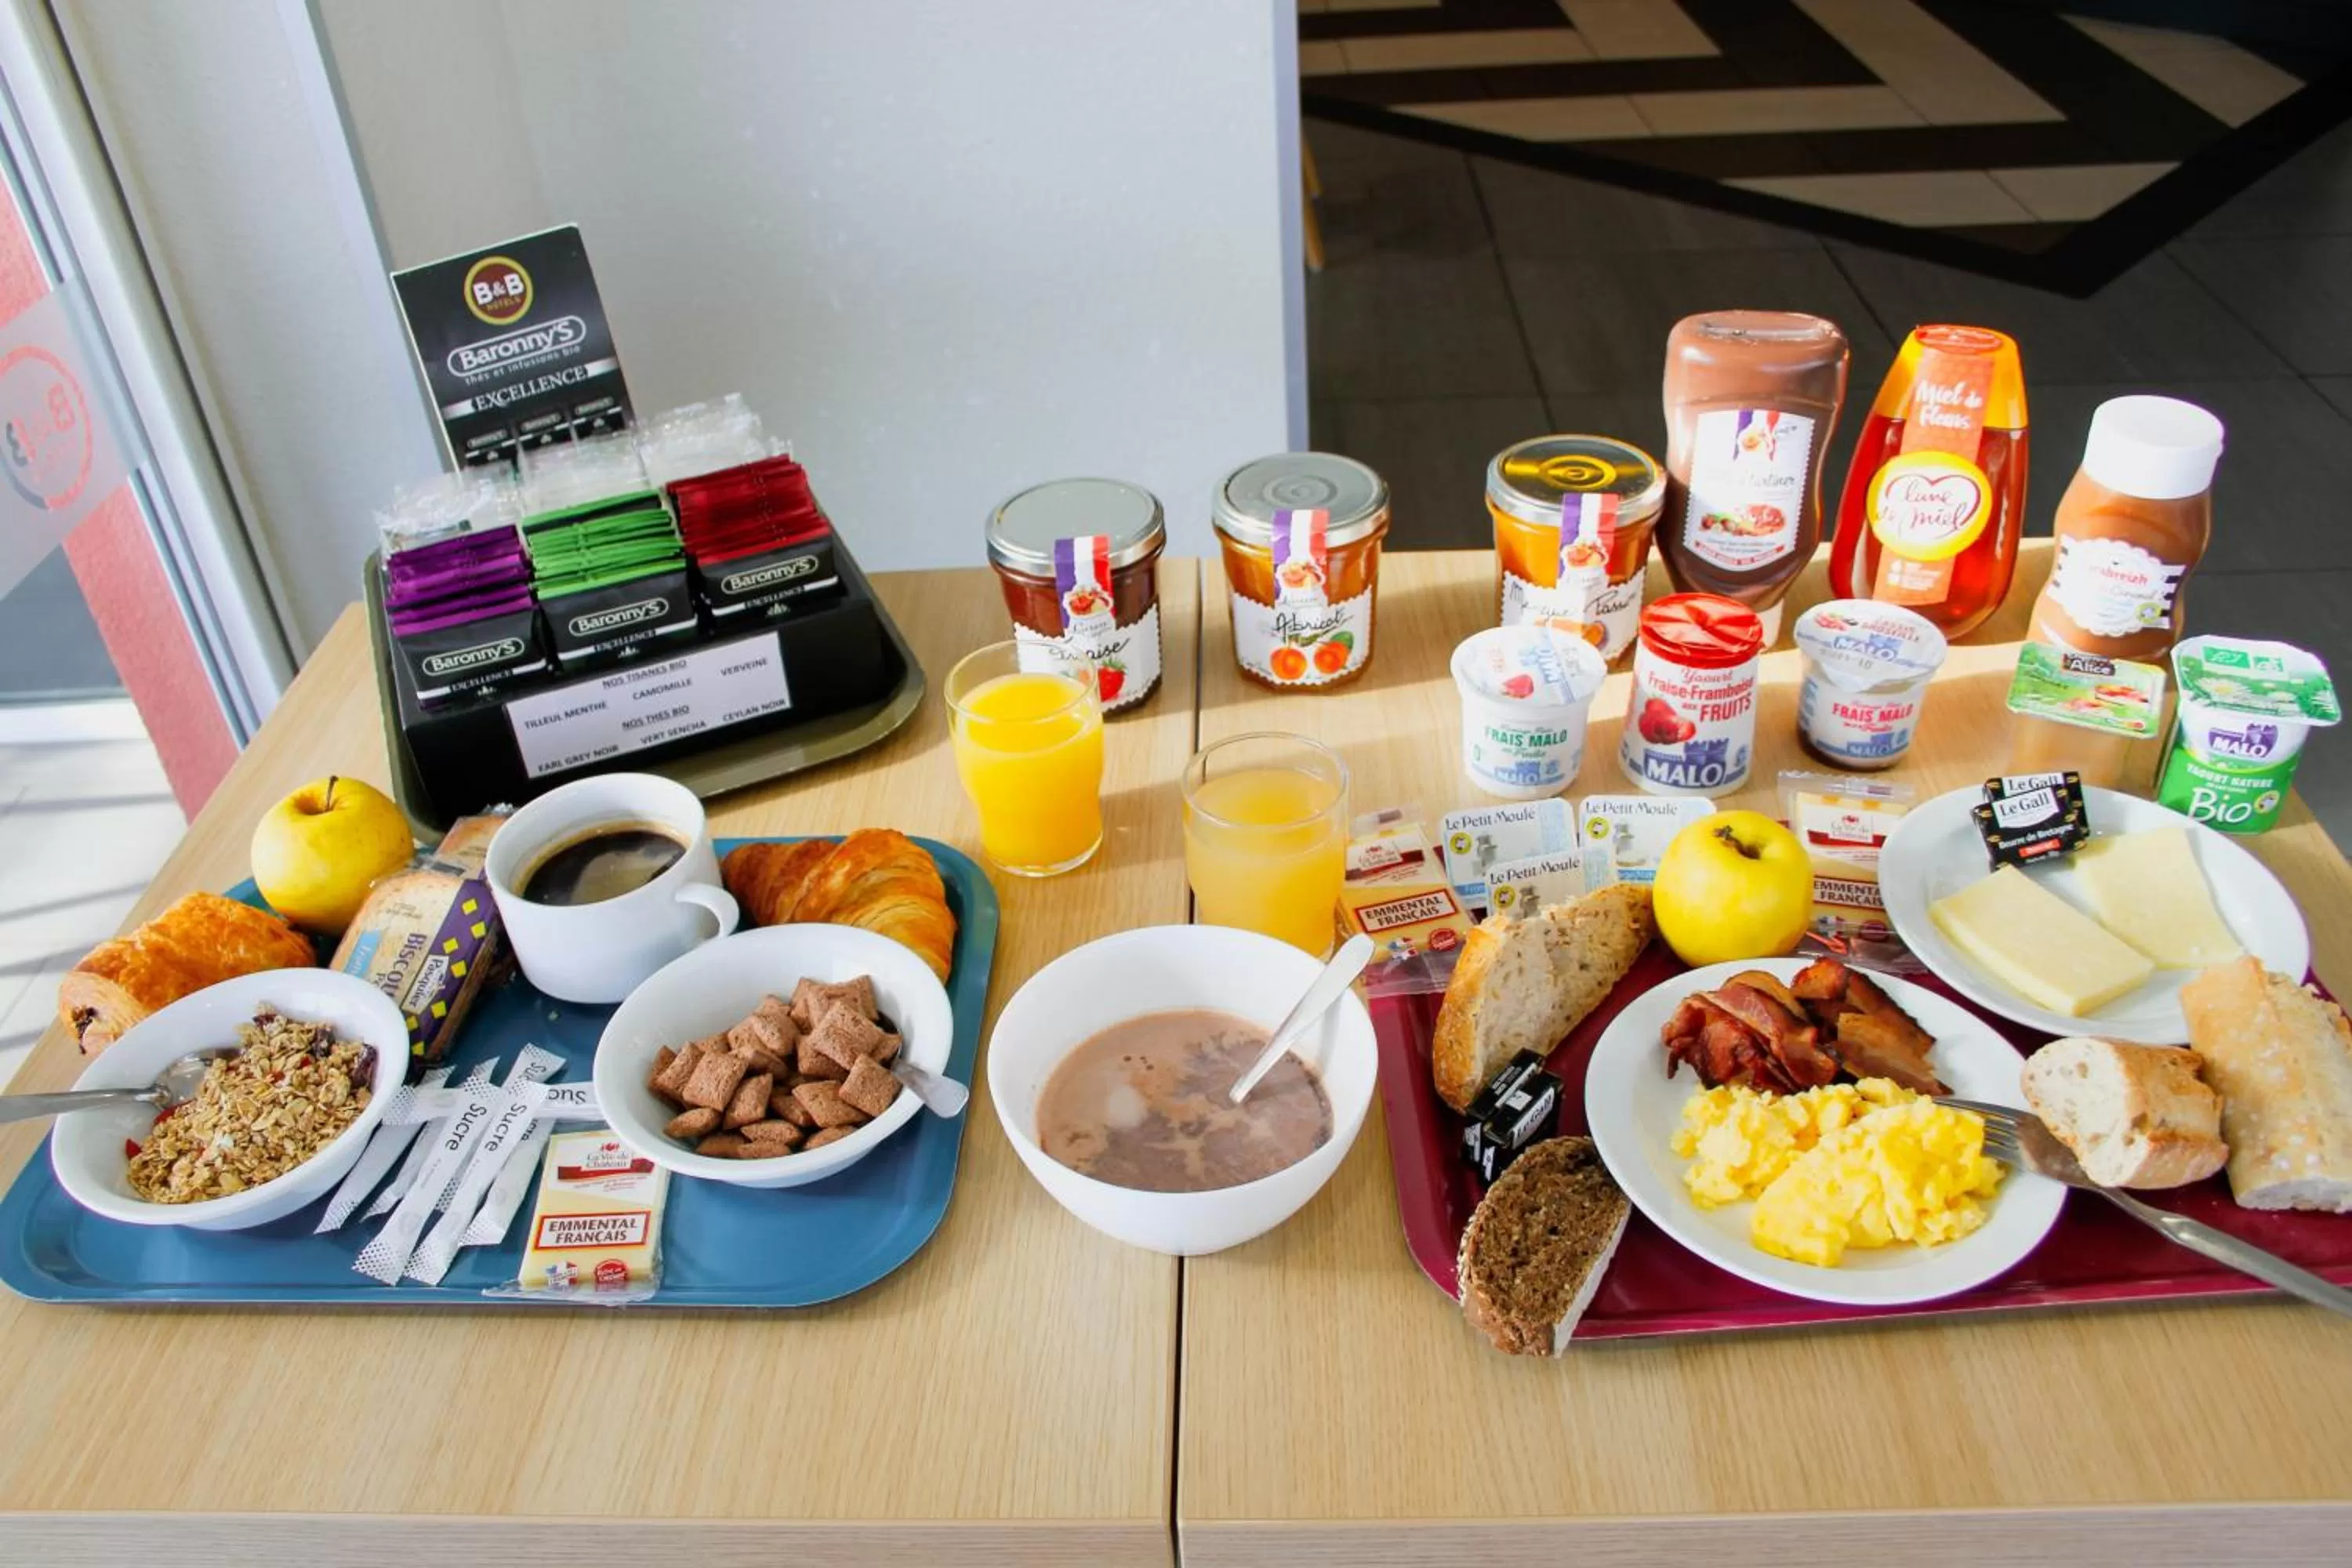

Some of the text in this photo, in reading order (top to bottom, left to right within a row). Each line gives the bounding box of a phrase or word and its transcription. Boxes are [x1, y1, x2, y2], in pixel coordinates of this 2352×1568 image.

[474, 273, 524, 305] B&B
[474, 365, 586, 412] EXCELLENCE
[1915, 379, 1963, 406] Miel
[1273, 608, 1352, 641] Abricot
[720, 657, 768, 677] VERVEINE
[2069, 658, 2111, 676] Alice
[633, 677, 692, 700] CAMOMILLE
[524, 700, 608, 730] TILLEUL MENTHE
[722, 706, 760, 722] CEYLAN
[1699, 691, 1752, 723] FRUITS
[1831, 702, 1875, 722] FRAIS
[666, 720, 707, 737] SENCHA
[1483, 725, 1524, 747] FRAIS
[1528, 728, 1568, 747] MALO
[565, 751, 591, 765] GREY
[593, 744, 619, 758] NOIR
[2212, 735, 2268, 757] MALO
[1647, 757, 1723, 788] MALO
[1585, 802, 1601, 814] Le
[1602, 802, 1633, 815] Petit
[2018, 791, 2051, 811] Gall
[2188, 786, 2252, 823] Bio
[1445, 818, 1461, 831] Le
[1461, 814, 1492, 829] Petit
[1490, 873, 1505, 886] Le
[1506, 866, 1537, 882] Petit
[1813, 880, 1881, 896] EMMENTA
[1365, 895, 1444, 920] EMMENTAL
[1376, 906, 1440, 927] FRANÇAIS
[445, 1102, 488, 1152] Sucre
[484, 1102, 528, 1153] Sucre
[549, 1218, 638, 1232] EMMENTAL
[554, 1230, 628, 1245] FRANÇAIS
